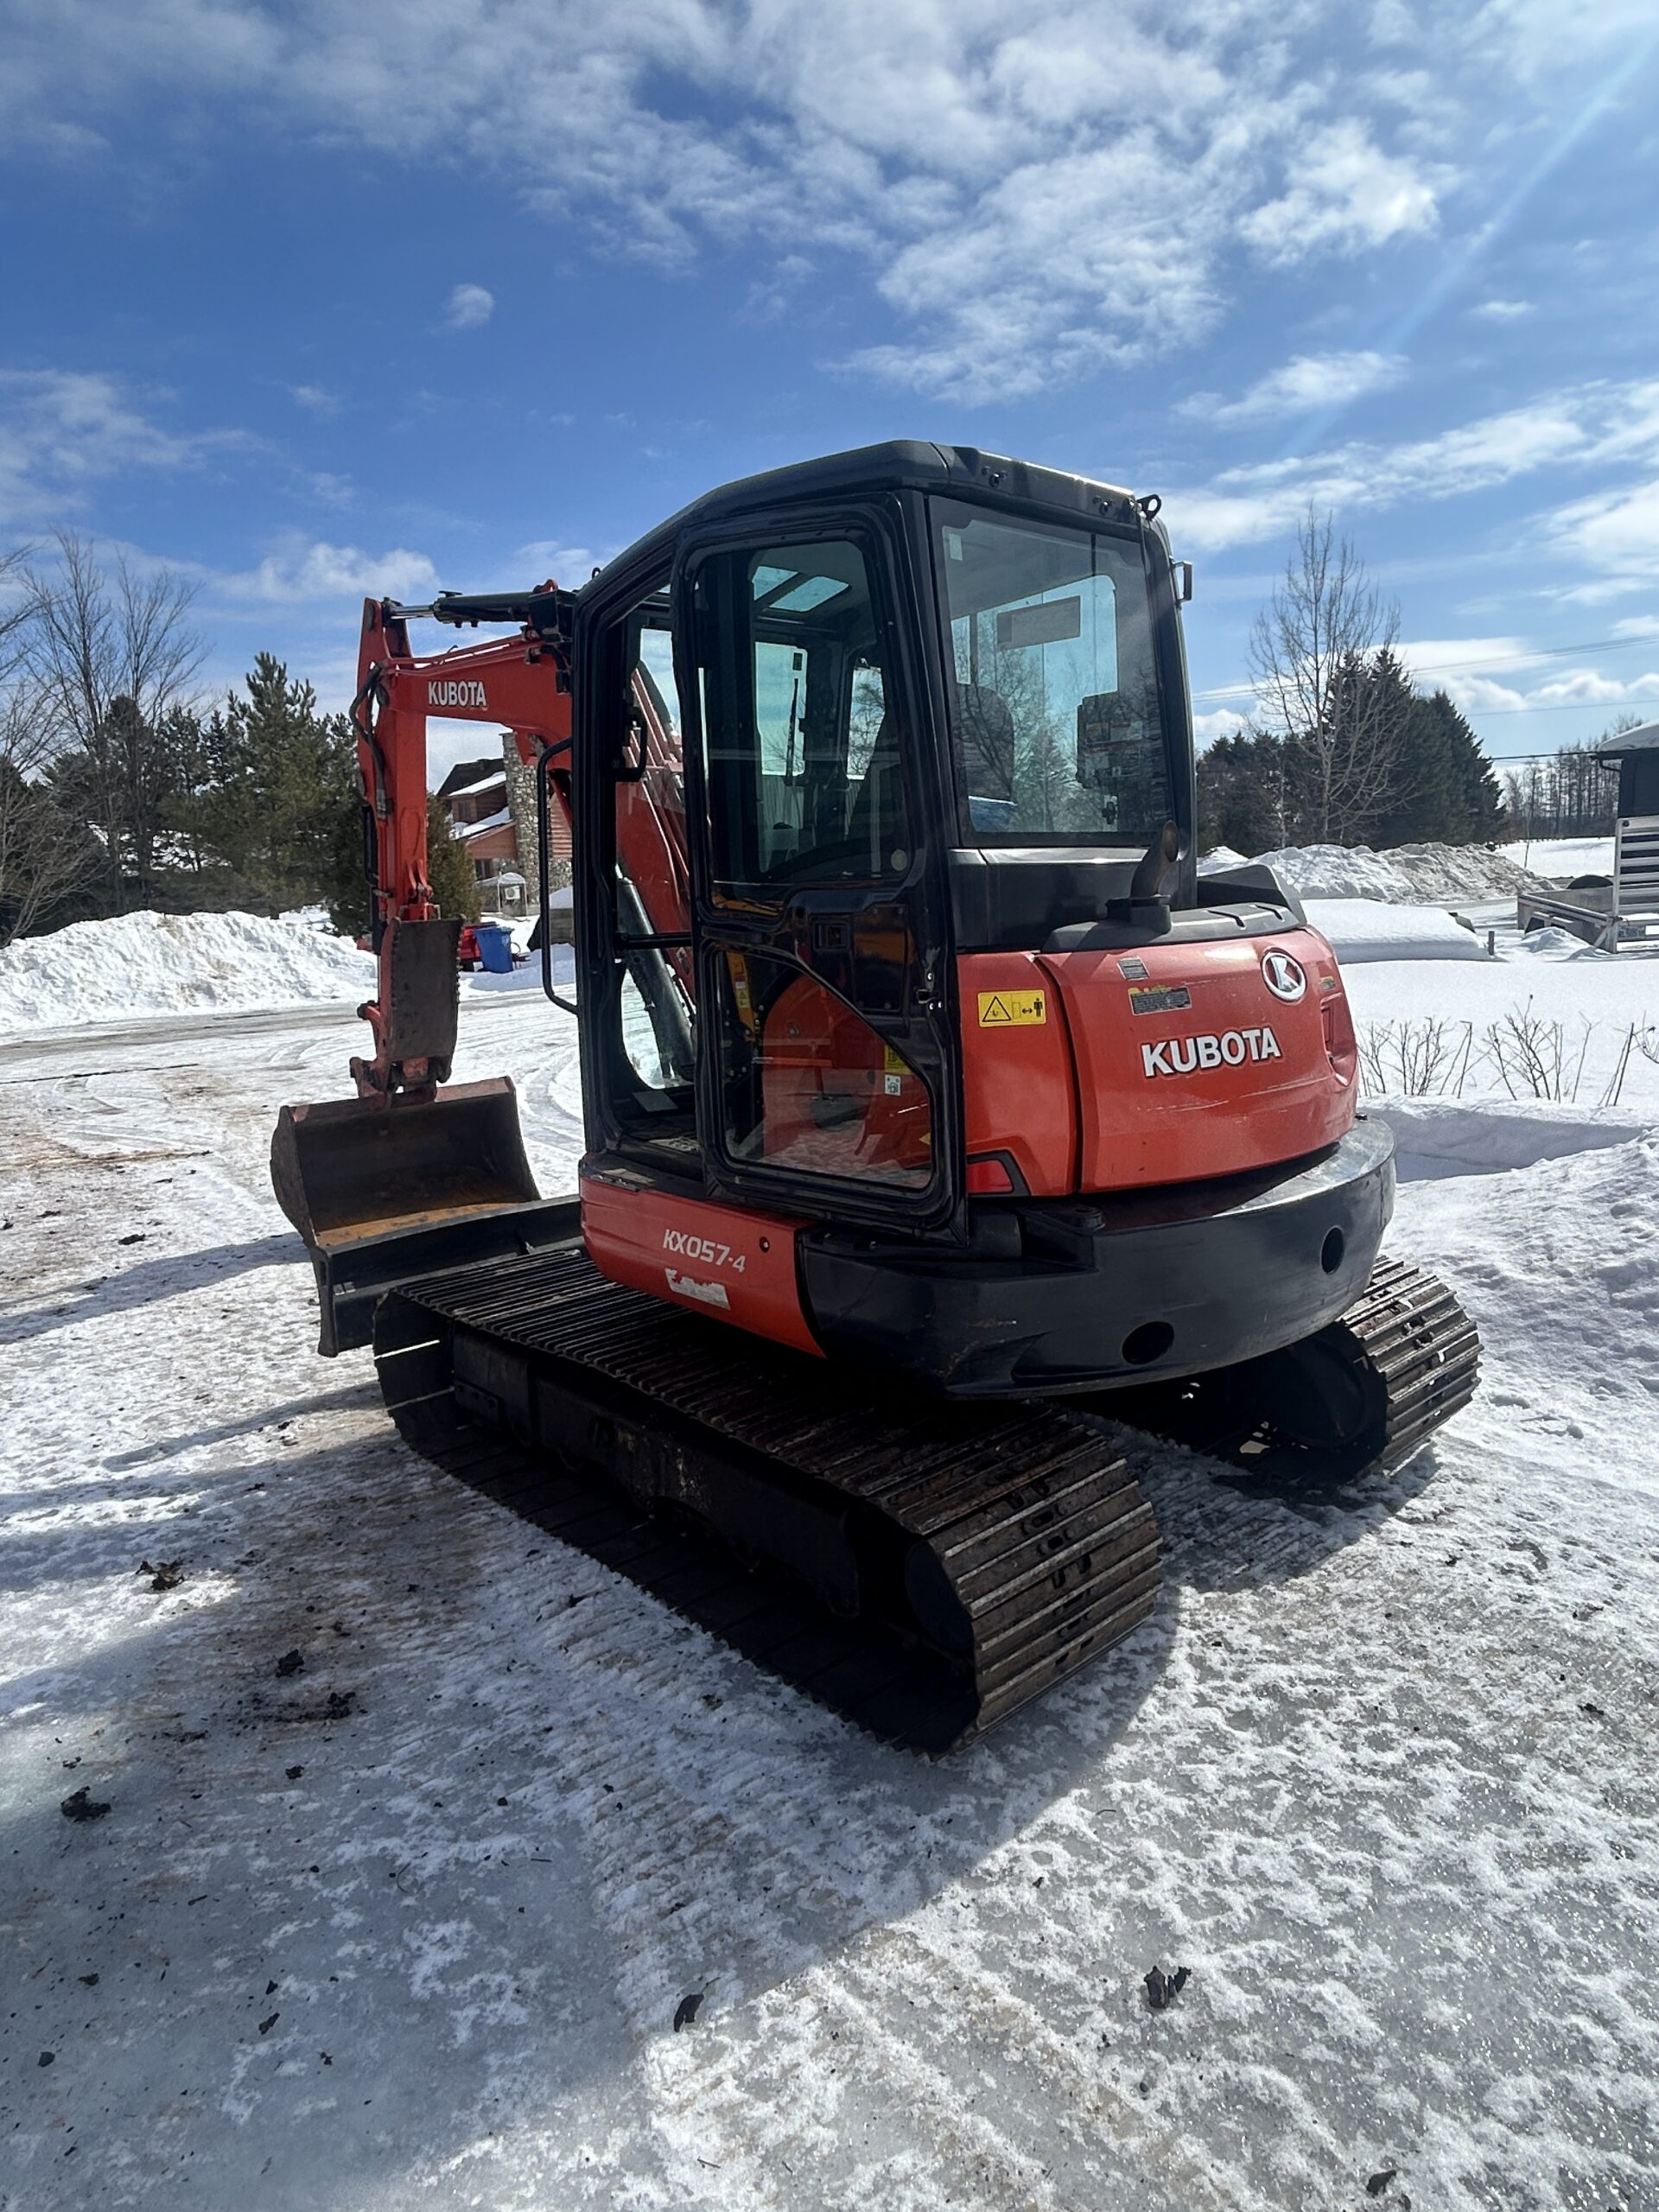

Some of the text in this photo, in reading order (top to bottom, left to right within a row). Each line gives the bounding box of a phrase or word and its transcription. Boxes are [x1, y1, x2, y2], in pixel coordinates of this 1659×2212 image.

[428, 680, 486, 706] KUBOTA
[1141, 1027, 1281, 1077] KUBOTA
[663, 1229, 746, 1273] KX057-4
